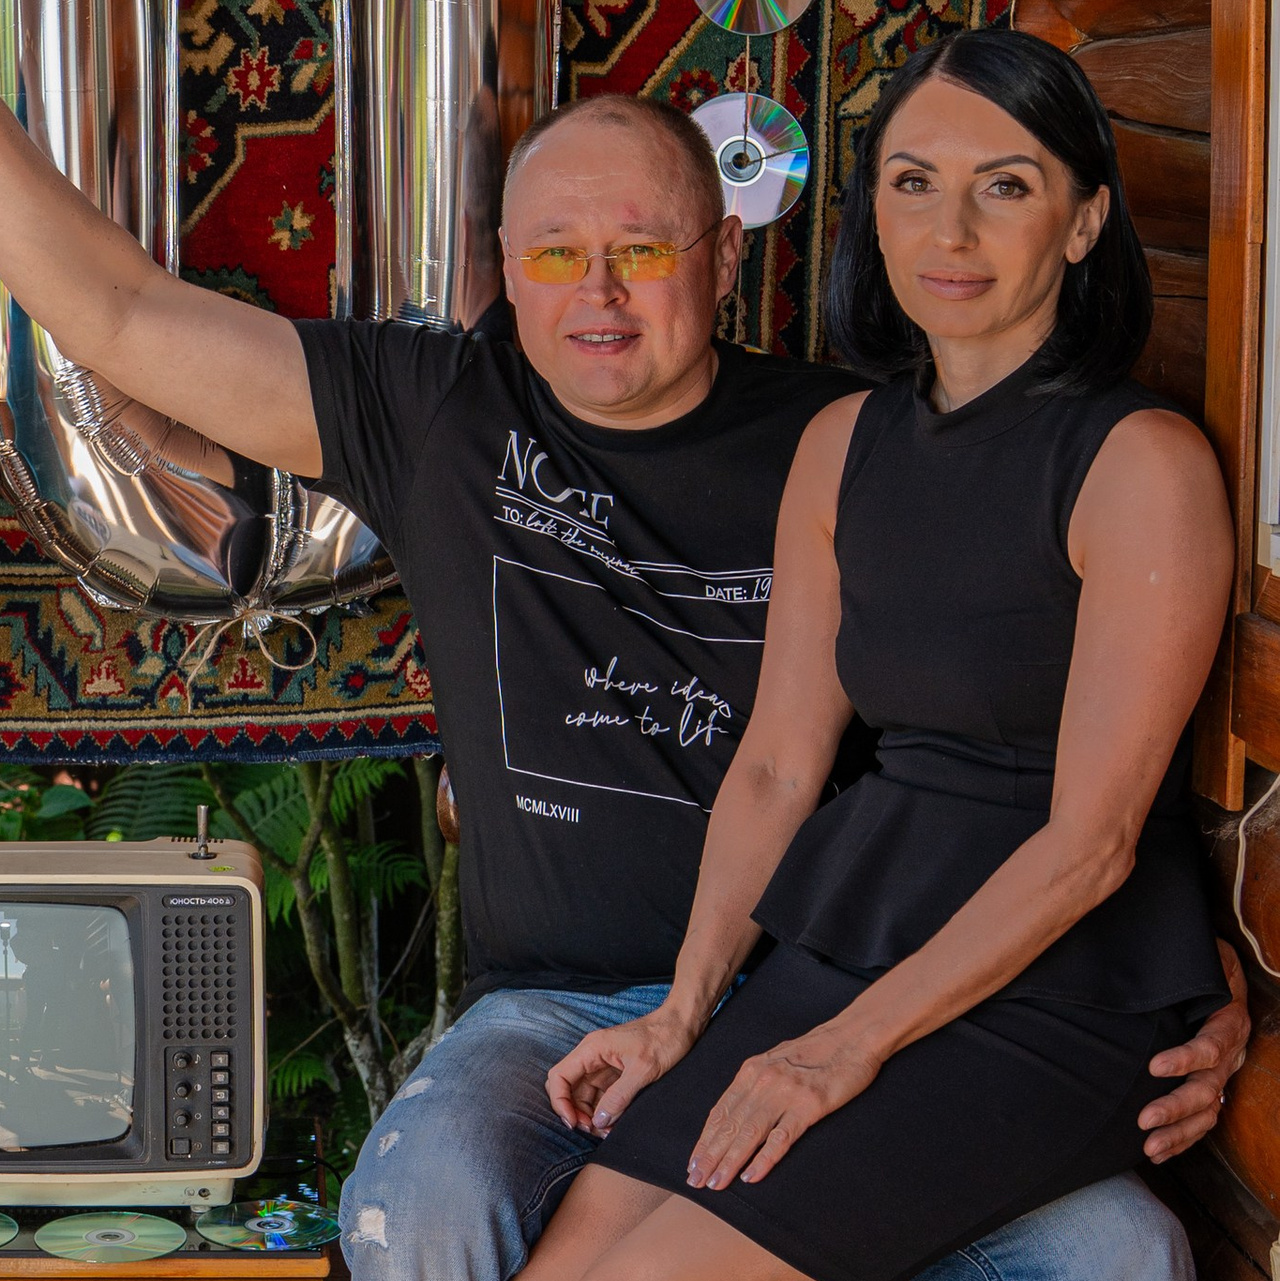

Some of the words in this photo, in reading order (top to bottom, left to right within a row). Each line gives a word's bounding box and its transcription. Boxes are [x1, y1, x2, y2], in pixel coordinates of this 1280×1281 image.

[502, 505, 524, 525] TO:
[705, 584, 748, 601] DATE:
[584, 656, 658, 696] where
[565, 710, 630, 728] come
[634, 705, 671, 736] to
[515, 794, 579, 823] MCMLXVIII
